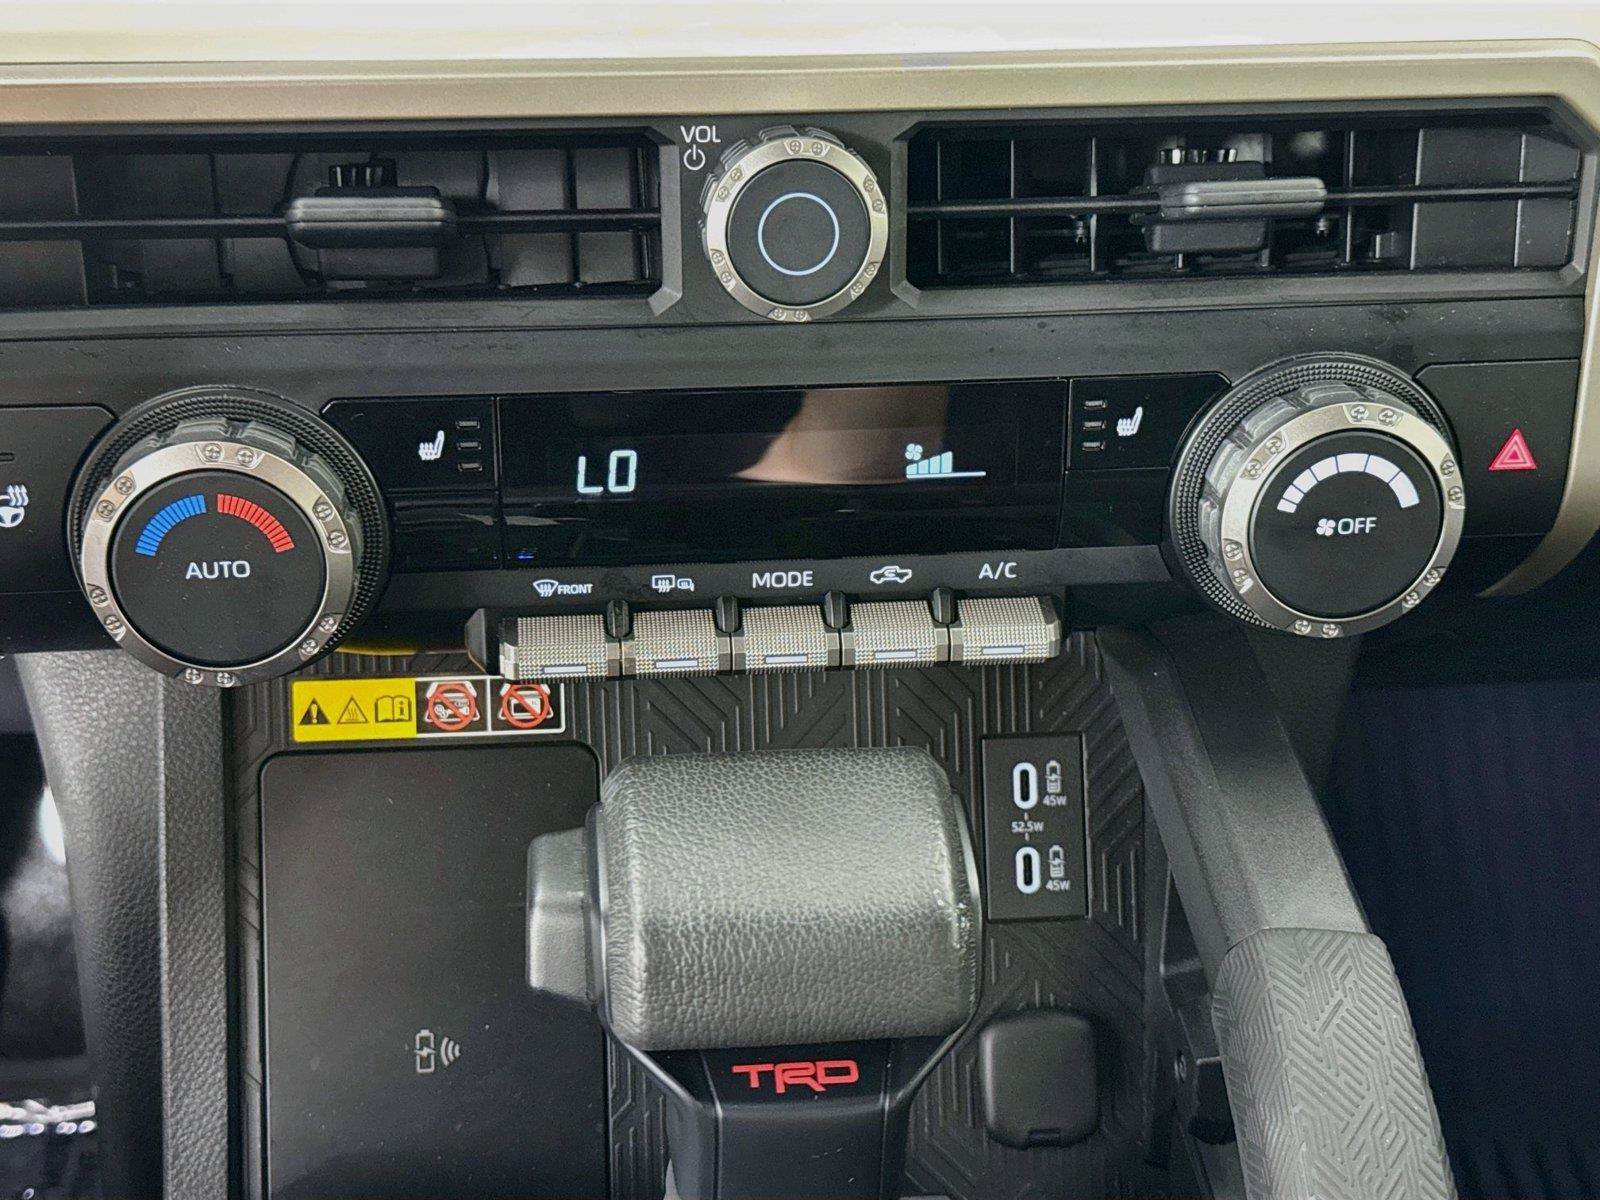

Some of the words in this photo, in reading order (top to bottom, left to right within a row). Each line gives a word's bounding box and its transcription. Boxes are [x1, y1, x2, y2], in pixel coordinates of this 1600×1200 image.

[680, 125, 721, 143] VOL
[577, 449, 638, 496] LO
[1337, 516, 1378, 535] OFF
[185, 560, 251, 580] AUTO
[752, 570, 814, 589] MODE
[979, 561, 1018, 580] A/C
[557, 581, 593, 595] FRONT
[1043, 794, 1067, 807] 45W
[1011, 821, 1044, 833] 52.5W
[1046, 879, 1070, 891] 45W
[732, 1059, 859, 1094] TRD
